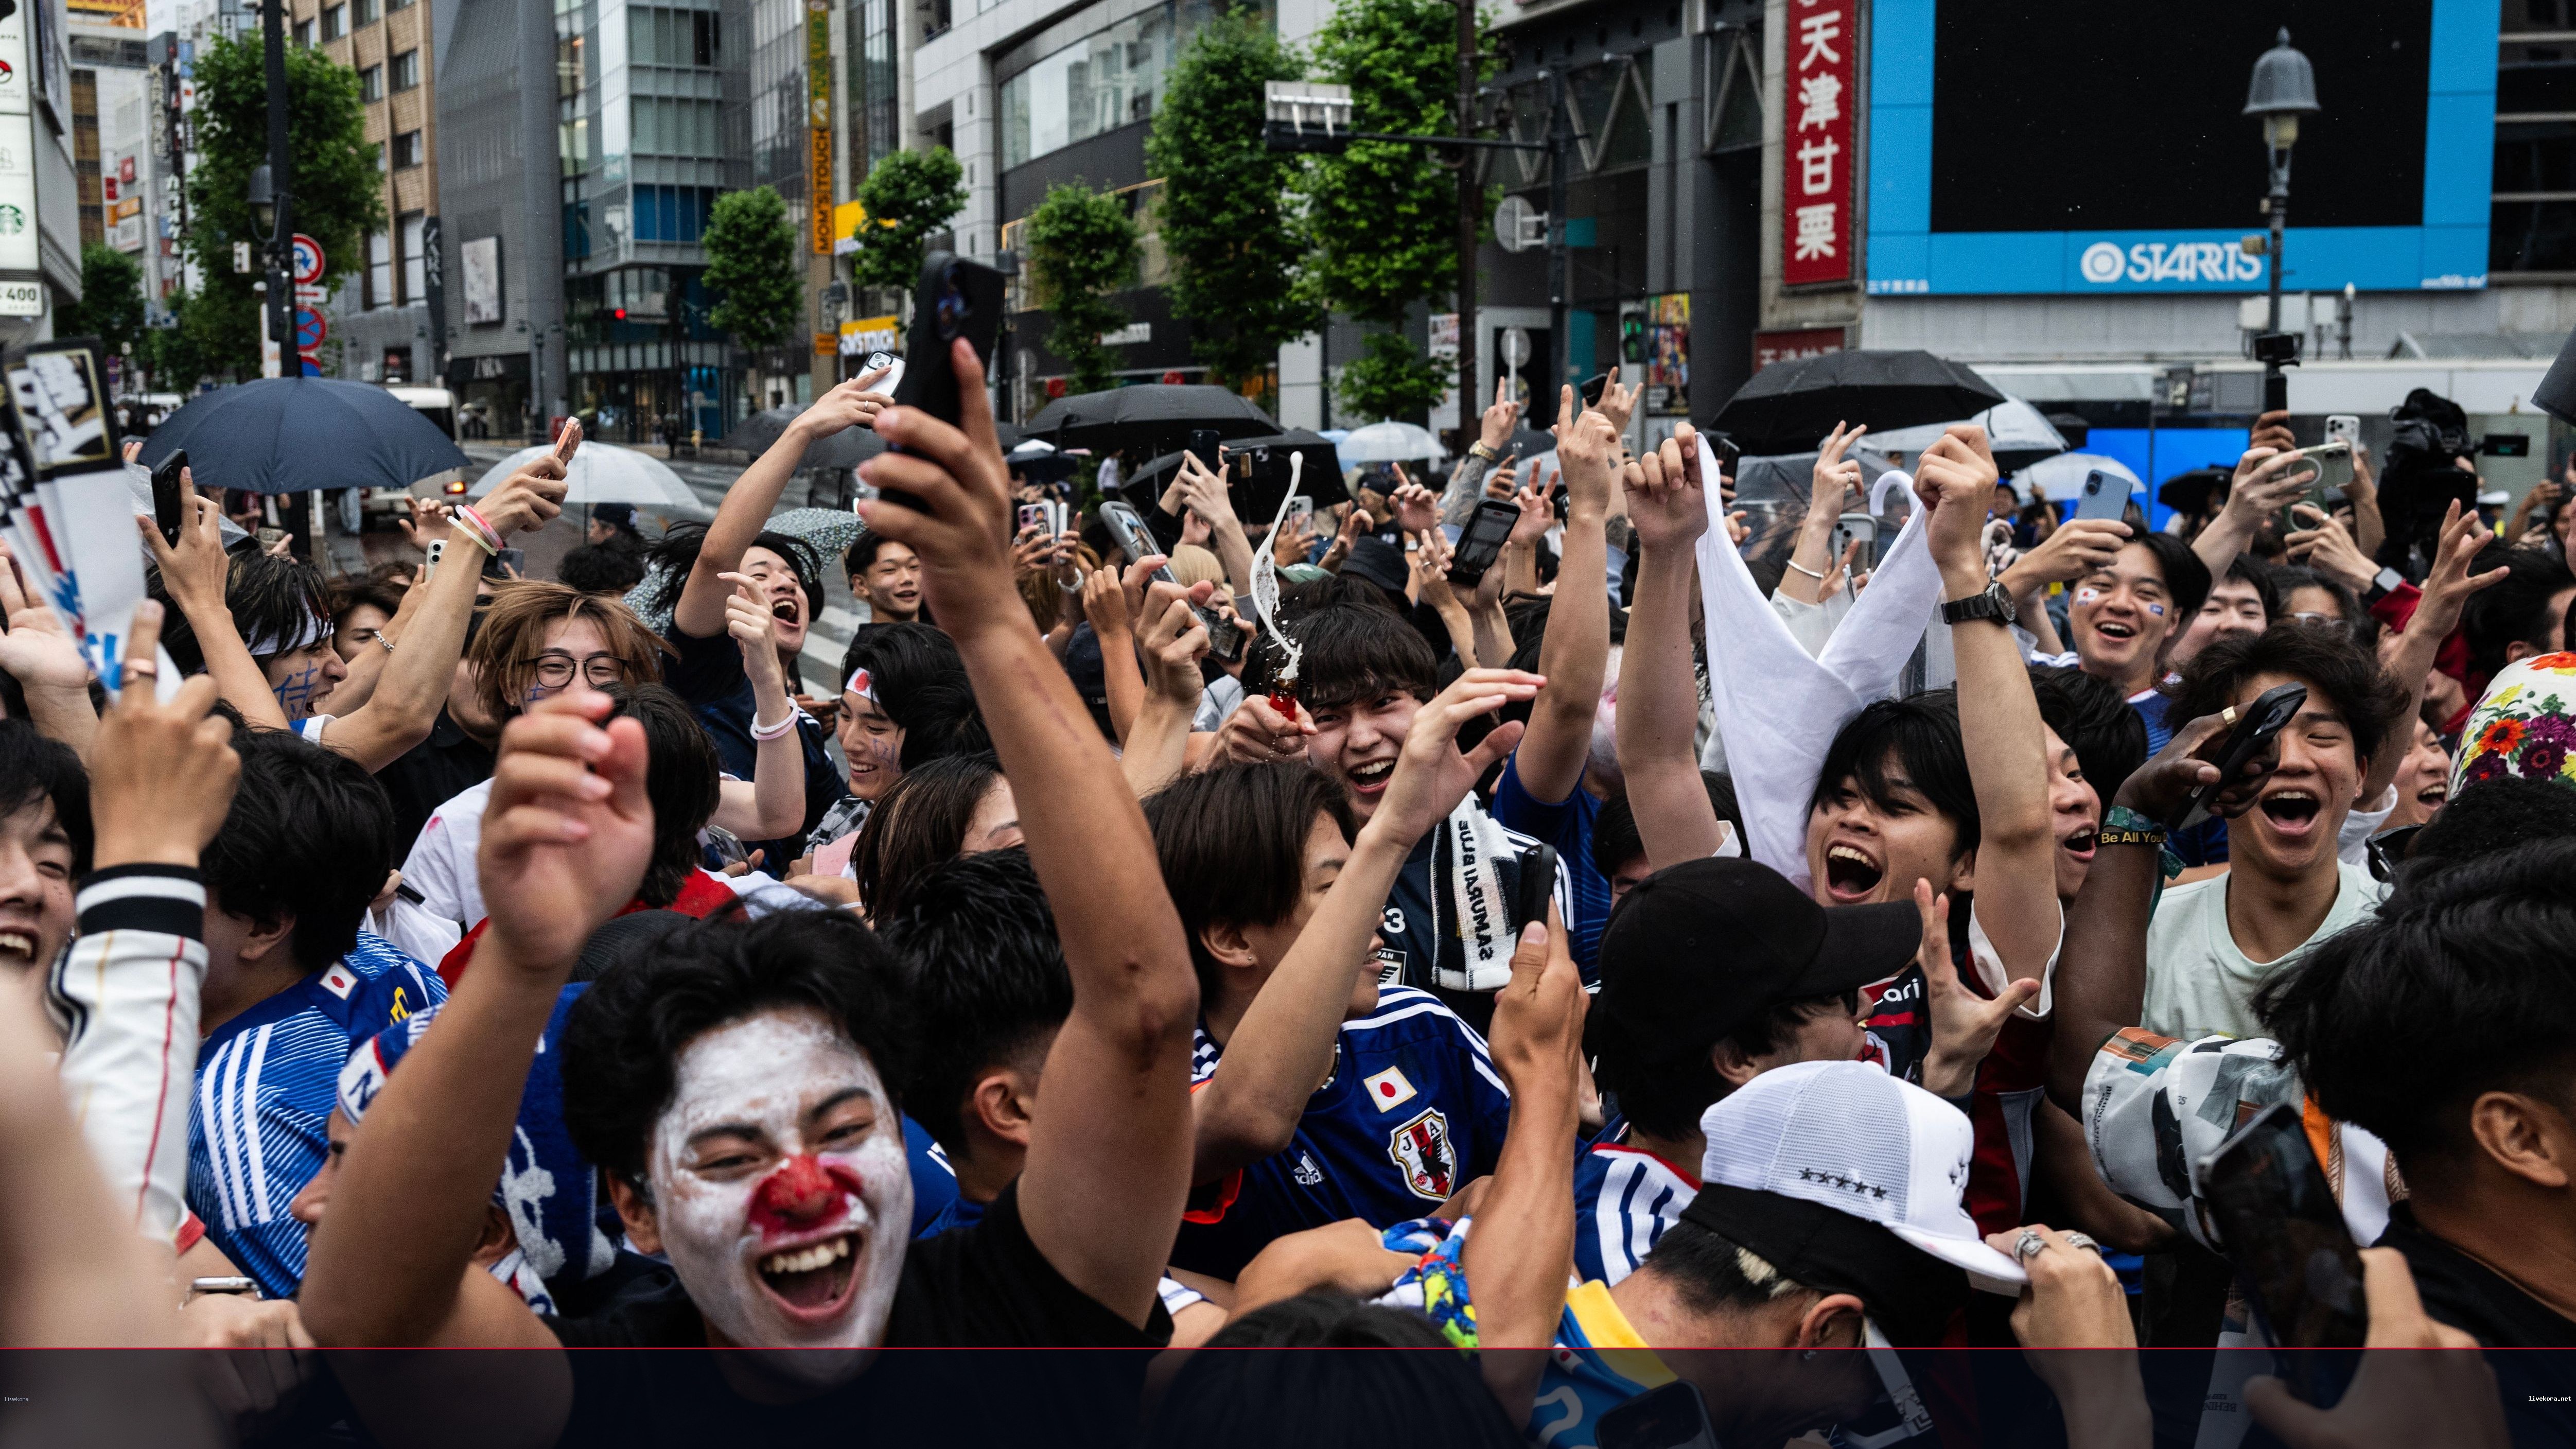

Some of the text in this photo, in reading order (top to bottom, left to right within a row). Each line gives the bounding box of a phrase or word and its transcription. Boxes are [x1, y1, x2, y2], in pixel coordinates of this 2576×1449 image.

[1794, 0, 1842, 261] 天津甘栗
[2127, 242, 2263, 283] STARTS
[2101, 833, 2118, 844] Be
[2122, 832, 2139, 843] All
[1383, 907, 1406, 933] 3
[1376, 951, 1394, 960] PAN
[1873, 977, 1920, 1005] ari
[2202, 1401, 2237, 1412] BEHIN
